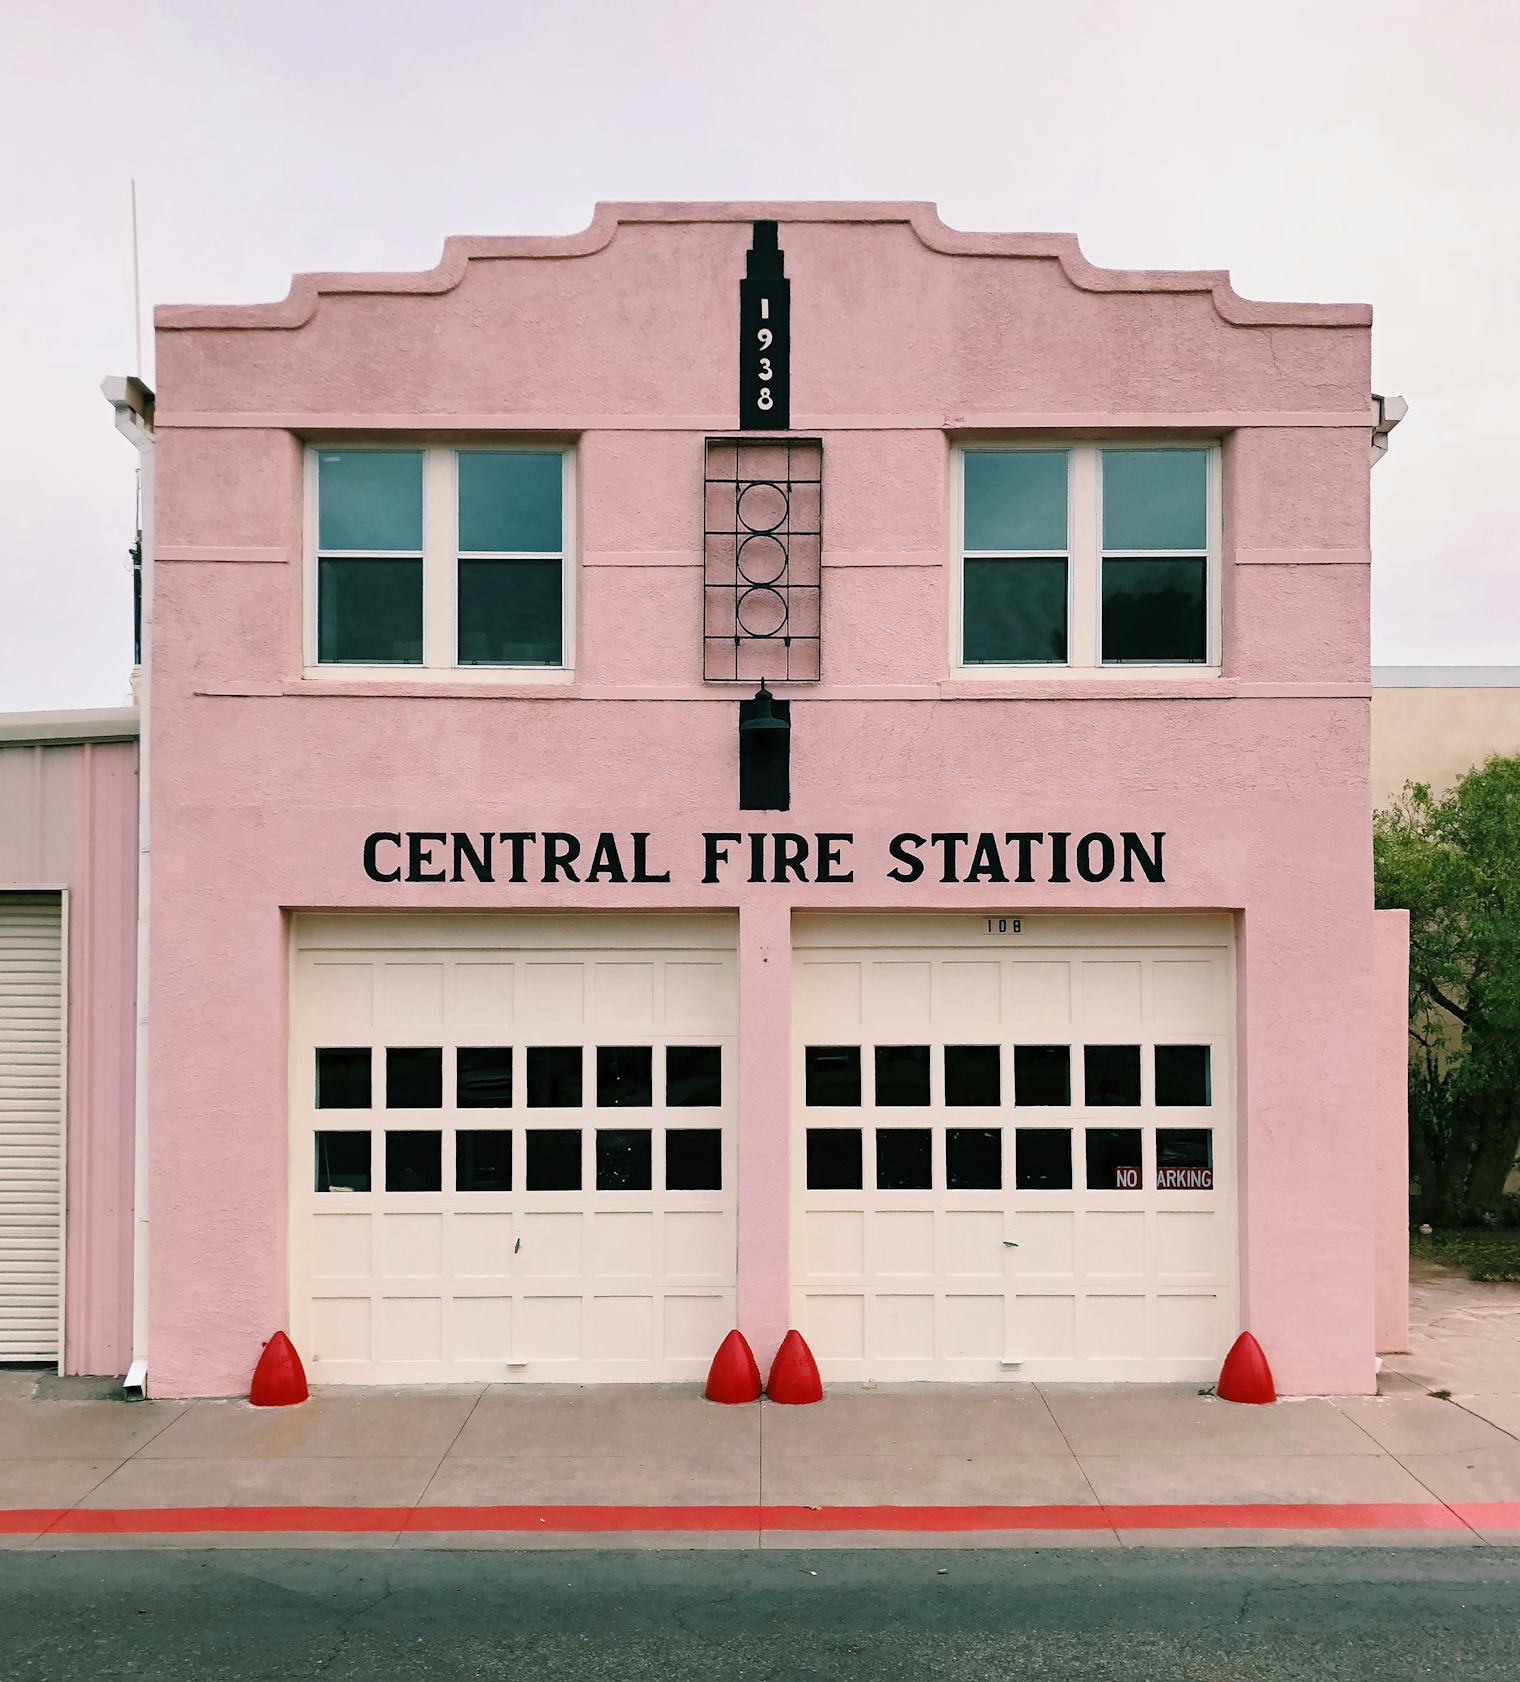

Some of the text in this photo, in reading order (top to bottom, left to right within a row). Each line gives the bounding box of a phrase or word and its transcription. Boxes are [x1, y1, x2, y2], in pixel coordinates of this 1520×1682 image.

[756, 298, 774, 411] 1938
[363, 831, 1166, 883] CENTRAL FIRE STATION
[988, 919, 1021, 933] 108
[1116, 1169, 1212, 1188] NO ARKING
